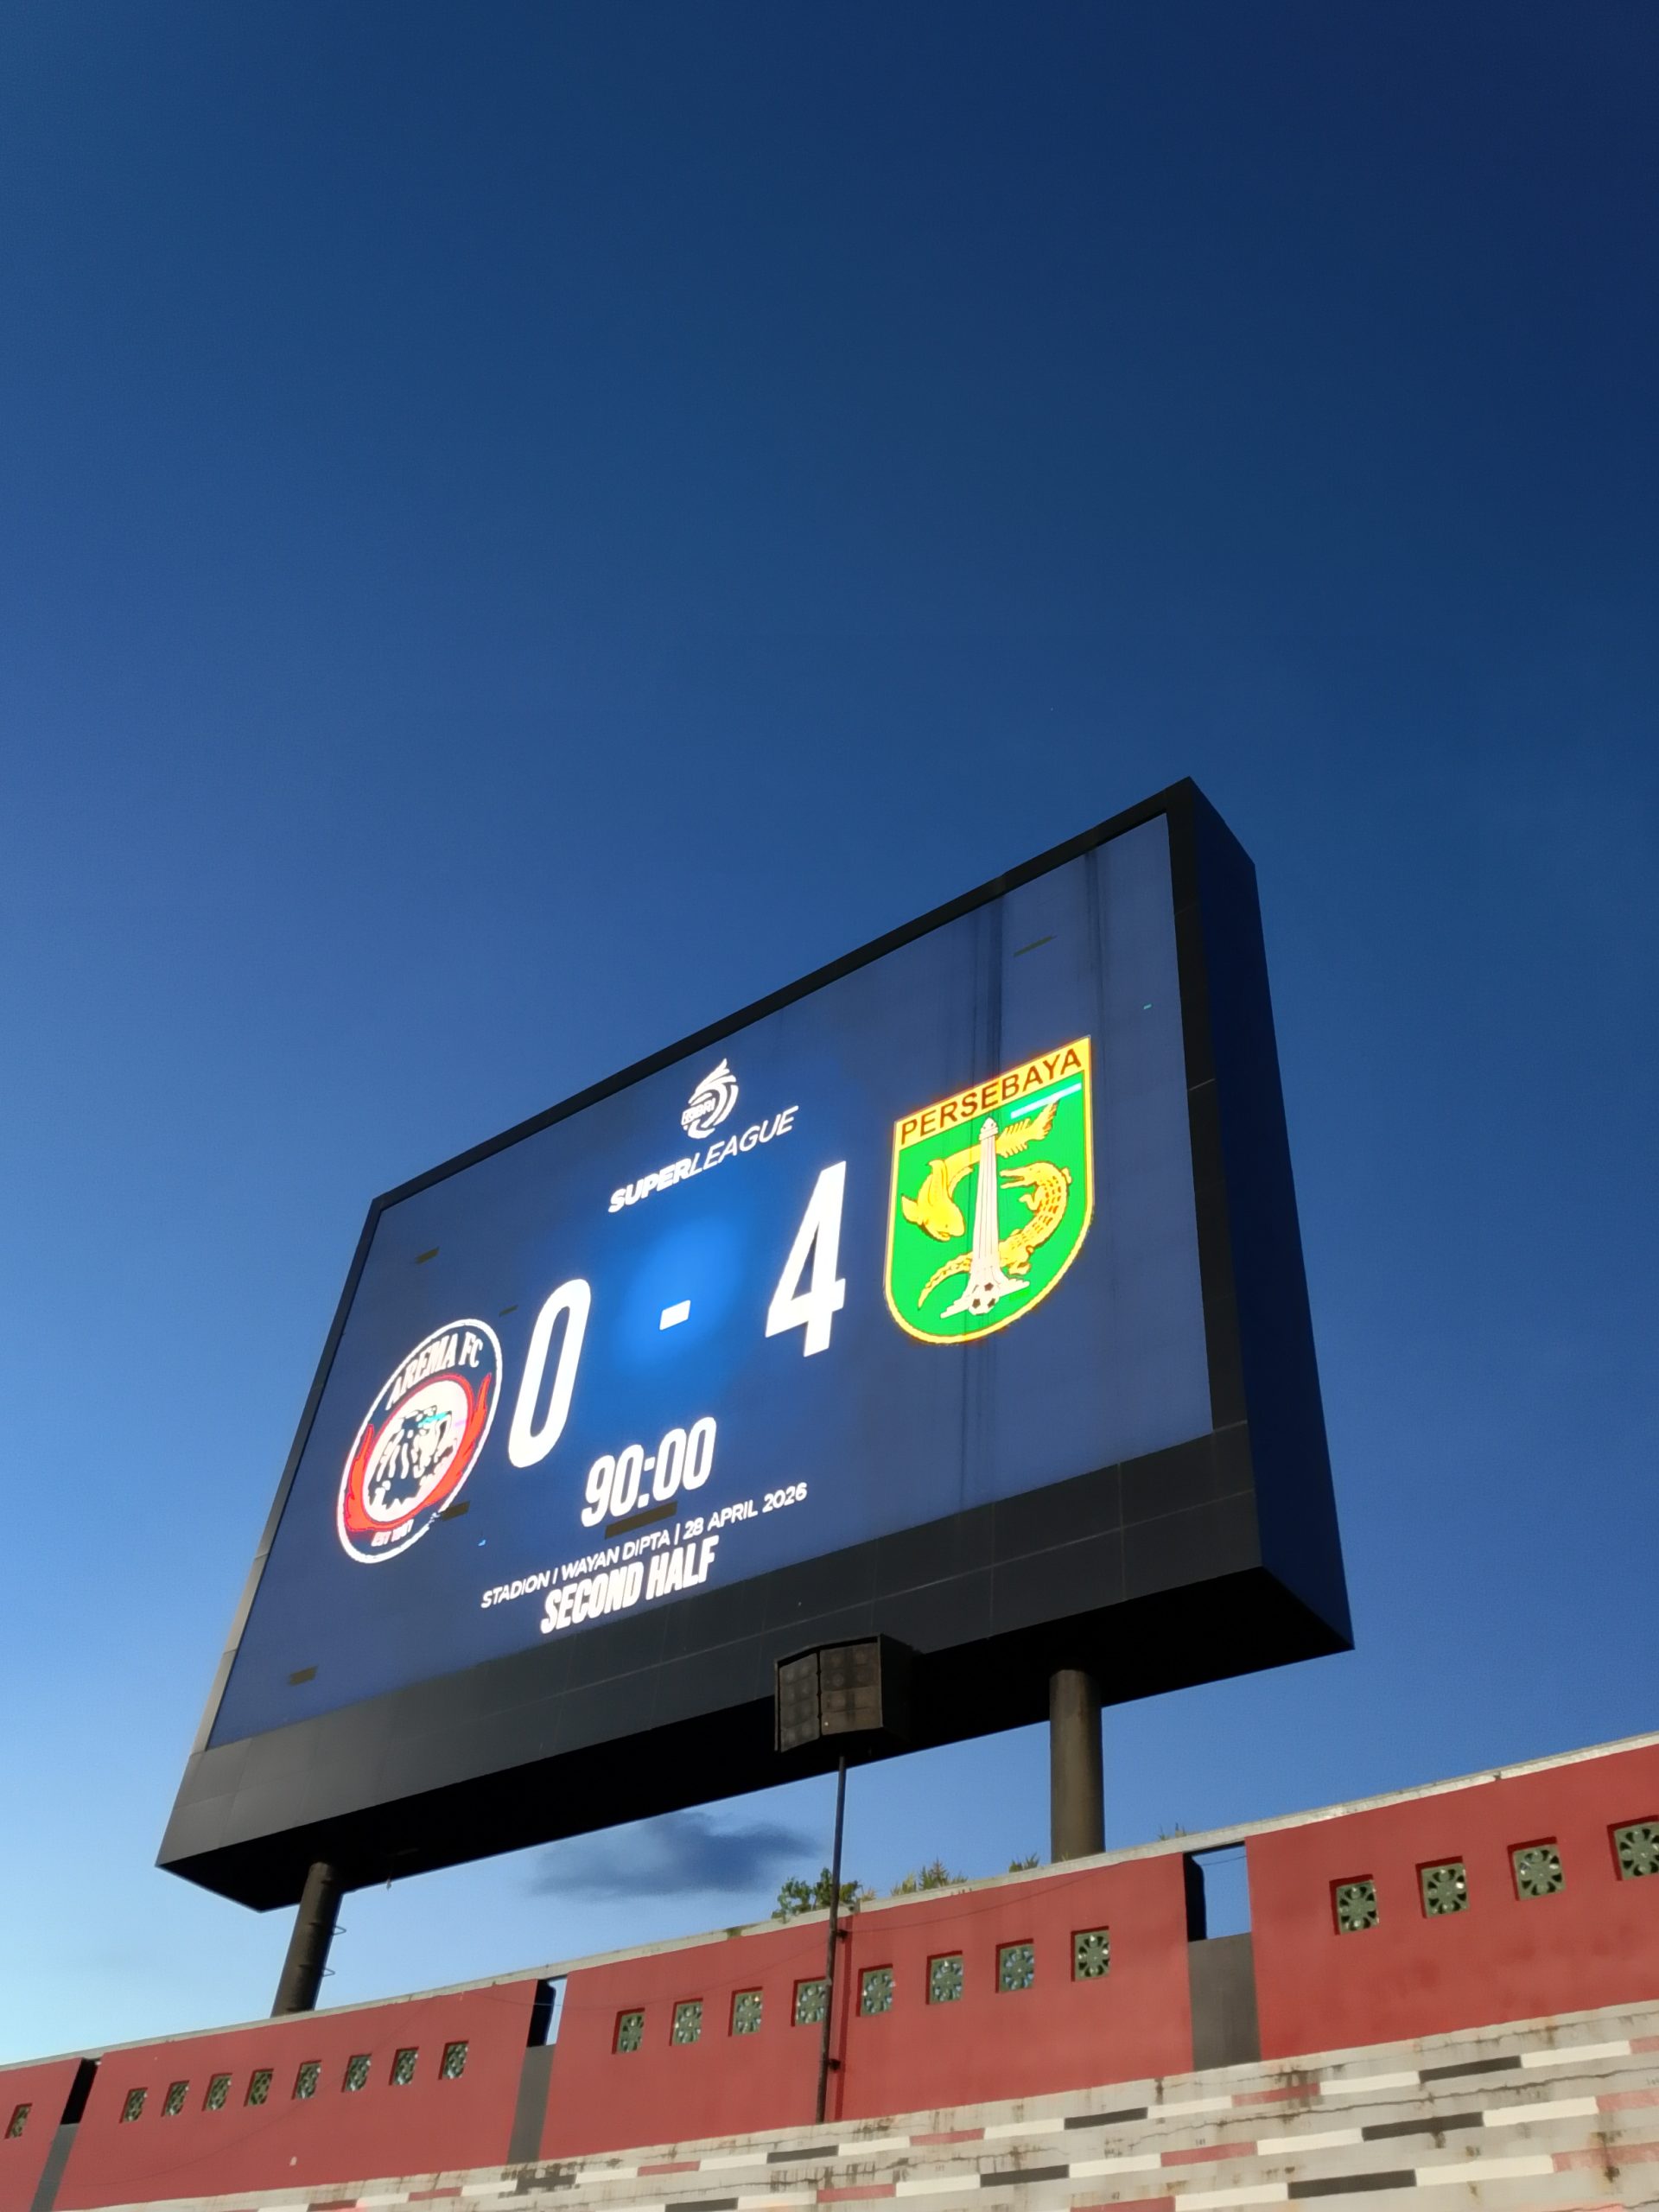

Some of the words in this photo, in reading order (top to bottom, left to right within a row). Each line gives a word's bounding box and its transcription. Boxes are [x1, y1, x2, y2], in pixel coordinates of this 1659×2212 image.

[900, 1048, 1082, 1145] PERSEBAYA
[607, 1105, 799, 1213] SUPERLEAGUE
[508, 1279, 591, 1468] 0
[659, 1300, 690, 1331] -
[766, 1161, 846, 1357] 4
[385, 1333, 458, 1411] AREMA
[458, 1332, 483, 1368] FC
[582, 1417, 716, 1528] 90:00
[480, 1570, 550, 1608] STADION
[562, 1546, 620, 1581] WAYAN
[622, 1529, 671, 1560] DIPTA
[683, 1517, 704, 1540] 28
[708, 1499, 758, 1531] APRIL
[762, 1482, 808, 1513] 2026
[540, 1561, 644, 1634] SECOND
[645, 1535, 719, 1600] HALF
